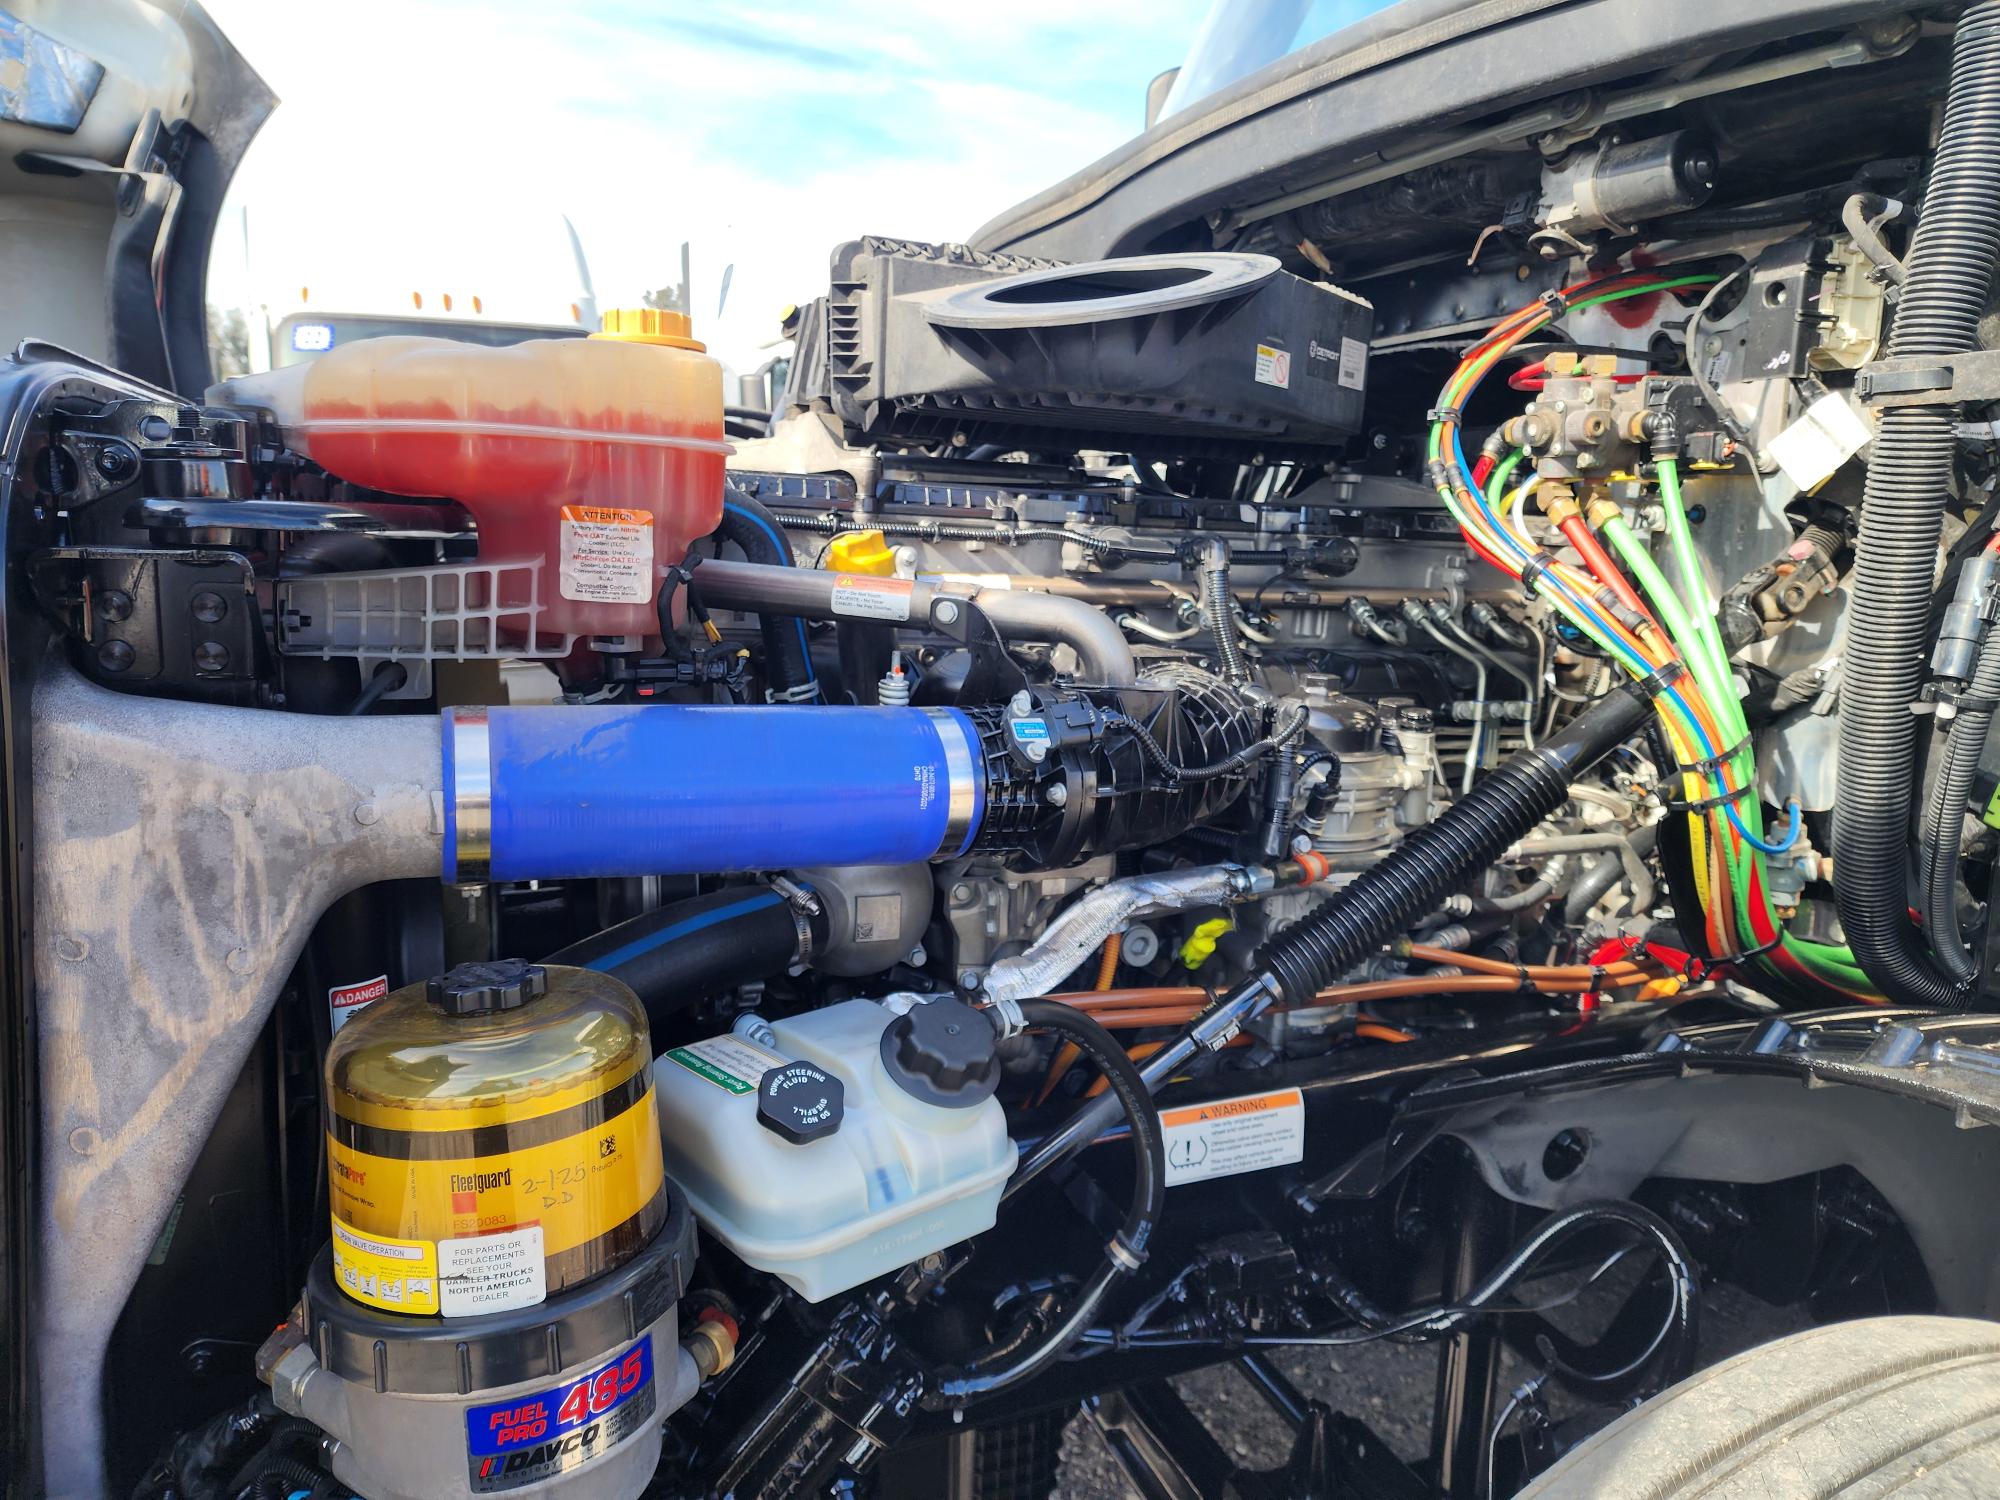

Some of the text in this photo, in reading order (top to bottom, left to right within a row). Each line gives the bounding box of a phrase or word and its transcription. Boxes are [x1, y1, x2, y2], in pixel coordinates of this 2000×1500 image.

[1316, 347, 1340, 361] DETROIT
[583, 511, 632, 521] ATTENTION
[920, 765, 928, 782] CHINA
[346, 984, 385, 1003] DANGER
[700, 1064, 728, 1082] Steering
[725, 1078, 746, 1090] Power
[769, 1068, 826, 1097] POWER STEERING
[782, 1076, 808, 1090] FLUID
[793, 1098, 829, 1116] OVERFILL
[1210, 1098, 1268, 1118] WARNING
[802, 1110, 831, 1125] DO NOT
[450, 1168, 511, 1194] Fleetguard
[454, 1214, 507, 1230] FS20083
[339, 1230, 405, 1258] DRAIN VALVE OPERATION
[454, 1241, 521, 1256] FOR PARTS OR
[452, 1249, 525, 1266] REPLACEMENTS
[446, 1266, 534, 1286] DAIMLER TRUCKS
[466, 1262, 512, 1274] SEE YOUR
[448, 1277, 532, 1295] NORTH AMERICA
[472, 1291, 509, 1303] DEALER
[556, 1348, 642, 1426] 485
[490, 1401, 548, 1430] FUEL
[497, 1420, 547, 1446] PRO
[505, 1423, 601, 1473] DAVCO
